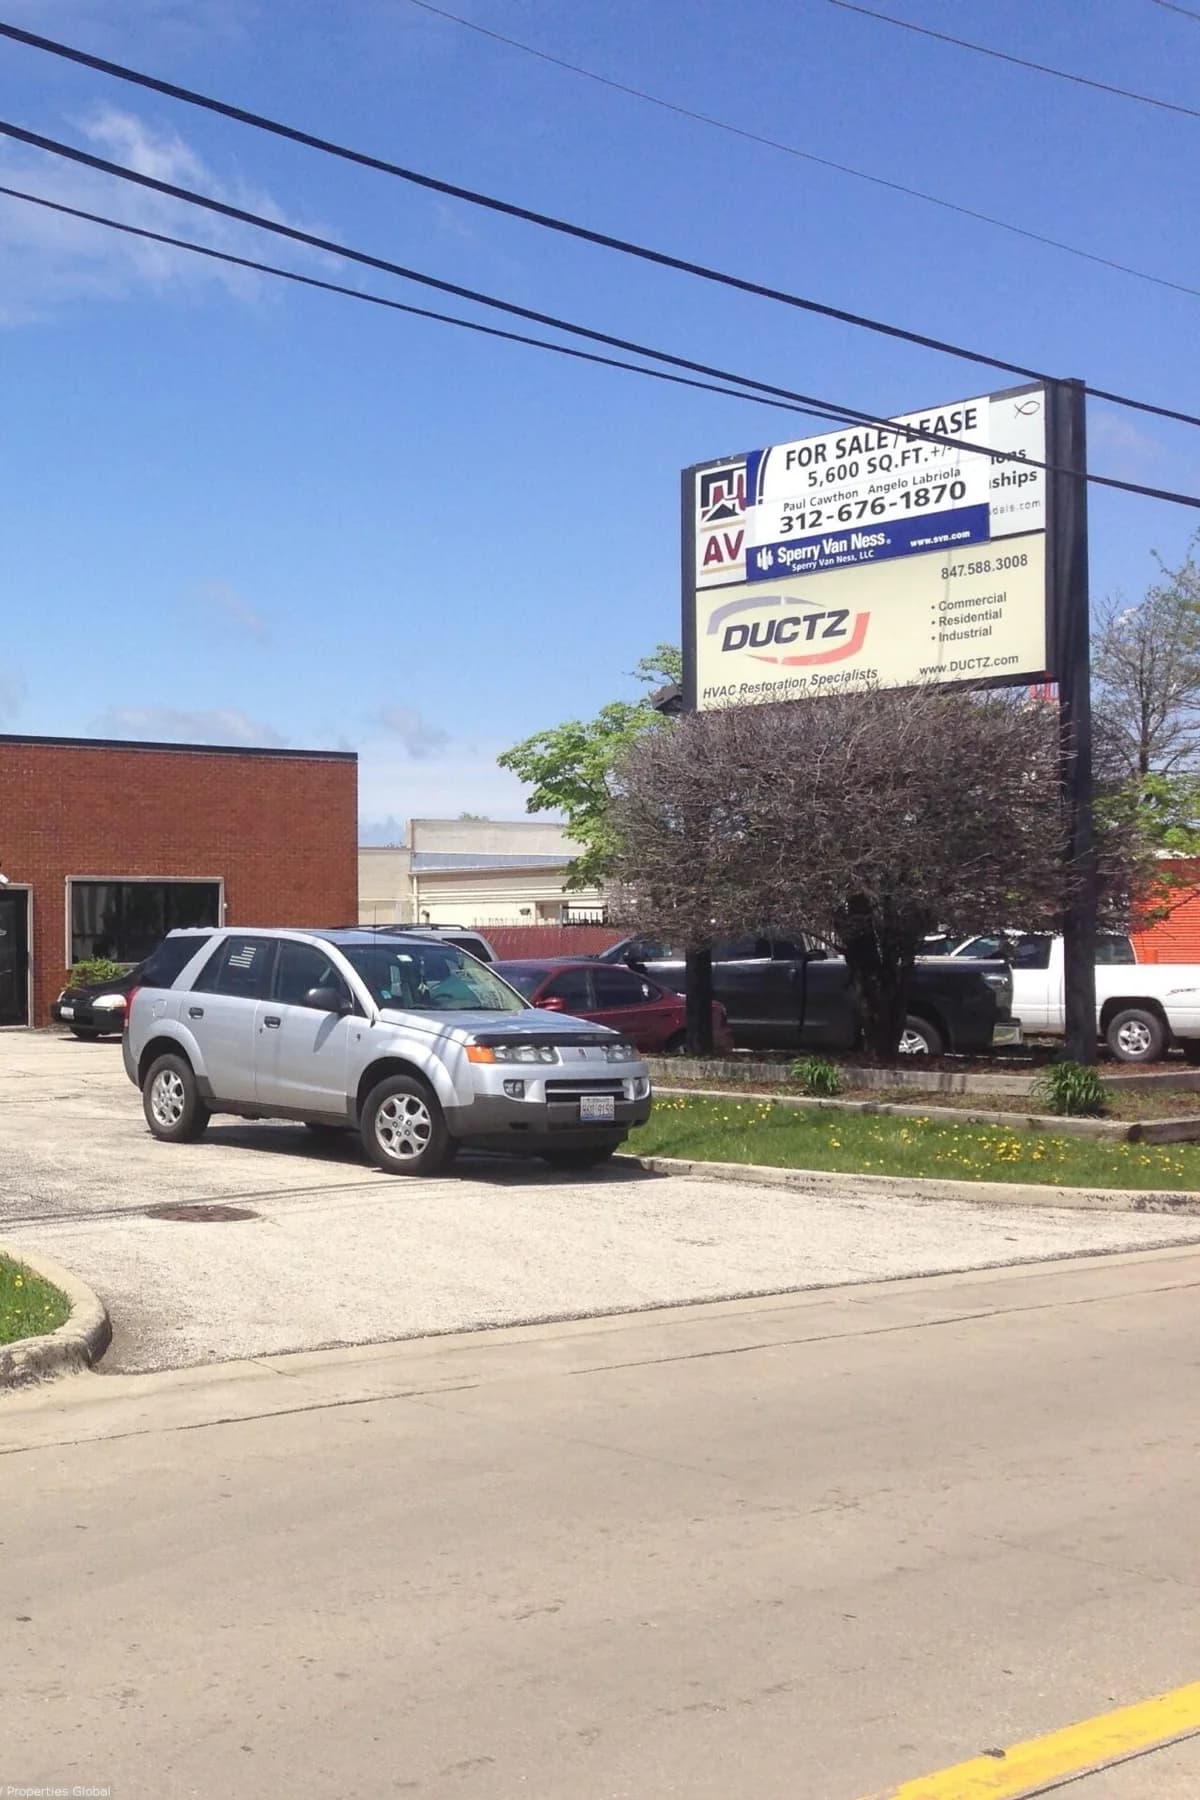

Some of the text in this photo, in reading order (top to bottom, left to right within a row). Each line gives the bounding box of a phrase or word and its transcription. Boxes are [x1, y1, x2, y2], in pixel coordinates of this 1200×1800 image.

[785, 443, 827, 471] FOR
[835, 428, 889, 460] SALE
[808, 462, 859, 488] 5,600
[866, 447, 928, 475] SQ.FT.
[989, 471, 1038, 489] ships
[783, 467, 961, 512] Paul Cawthon Angelo Labriola
[779, 480, 967, 534] 312-676-1870
[777, 541, 820, 566] Sperry
[823, 537, 848, 555] Van
[910, 530, 970, 548] www.svn.com
[792, 550, 875, 572] Sperry Van Ness, LLC
[941, 553, 1028, 580] 847.588.3008
[938, 591, 1008, 612] Commercial
[721, 608, 850, 652] DUCTZ
[938, 607, 1003, 628] Residential
[938, 625, 993, 643] Industrial
[919, 655, 1019, 675] www.DUCTZ.com
[703, 667, 878, 699] HVAC Restoration Specialists
